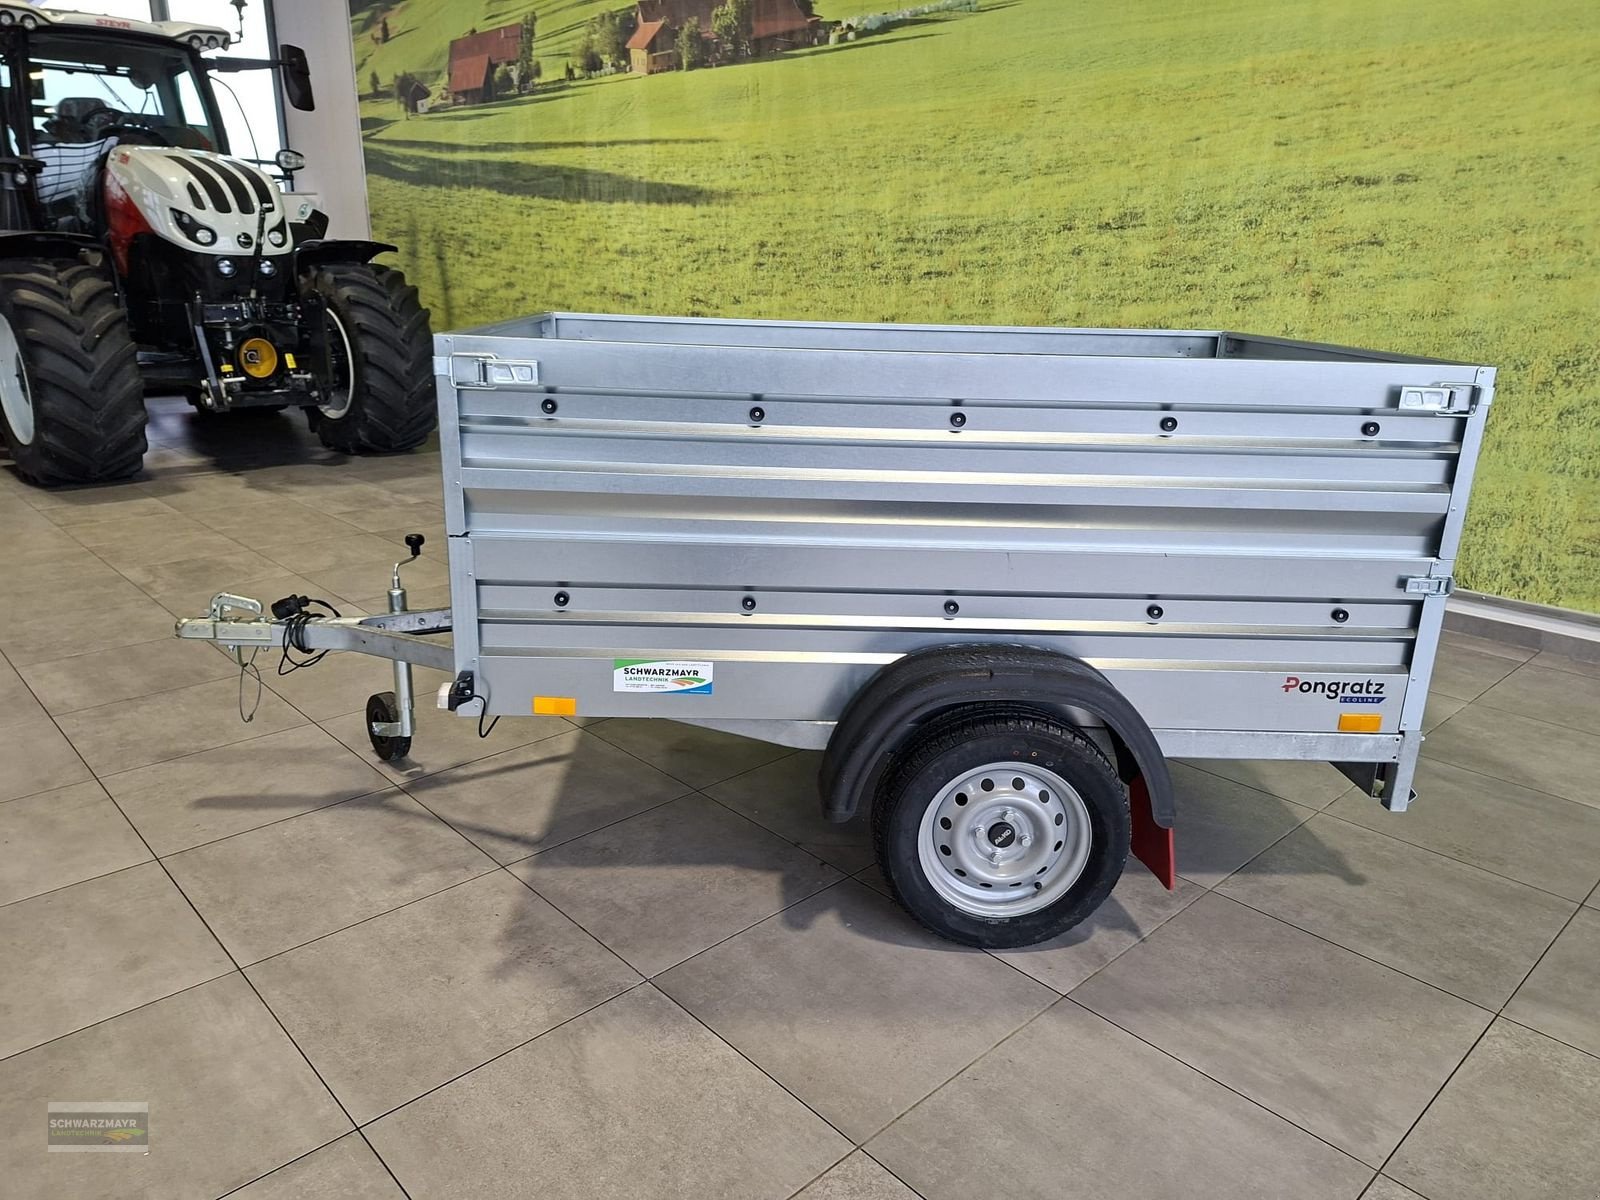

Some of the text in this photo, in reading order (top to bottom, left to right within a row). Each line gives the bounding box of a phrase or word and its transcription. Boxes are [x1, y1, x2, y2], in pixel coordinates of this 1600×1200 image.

[95, 18, 131, 29] STEYR
[623, 667, 700, 677] SCHWARZMAYR
[1281, 676, 1386, 700] Pongratz
